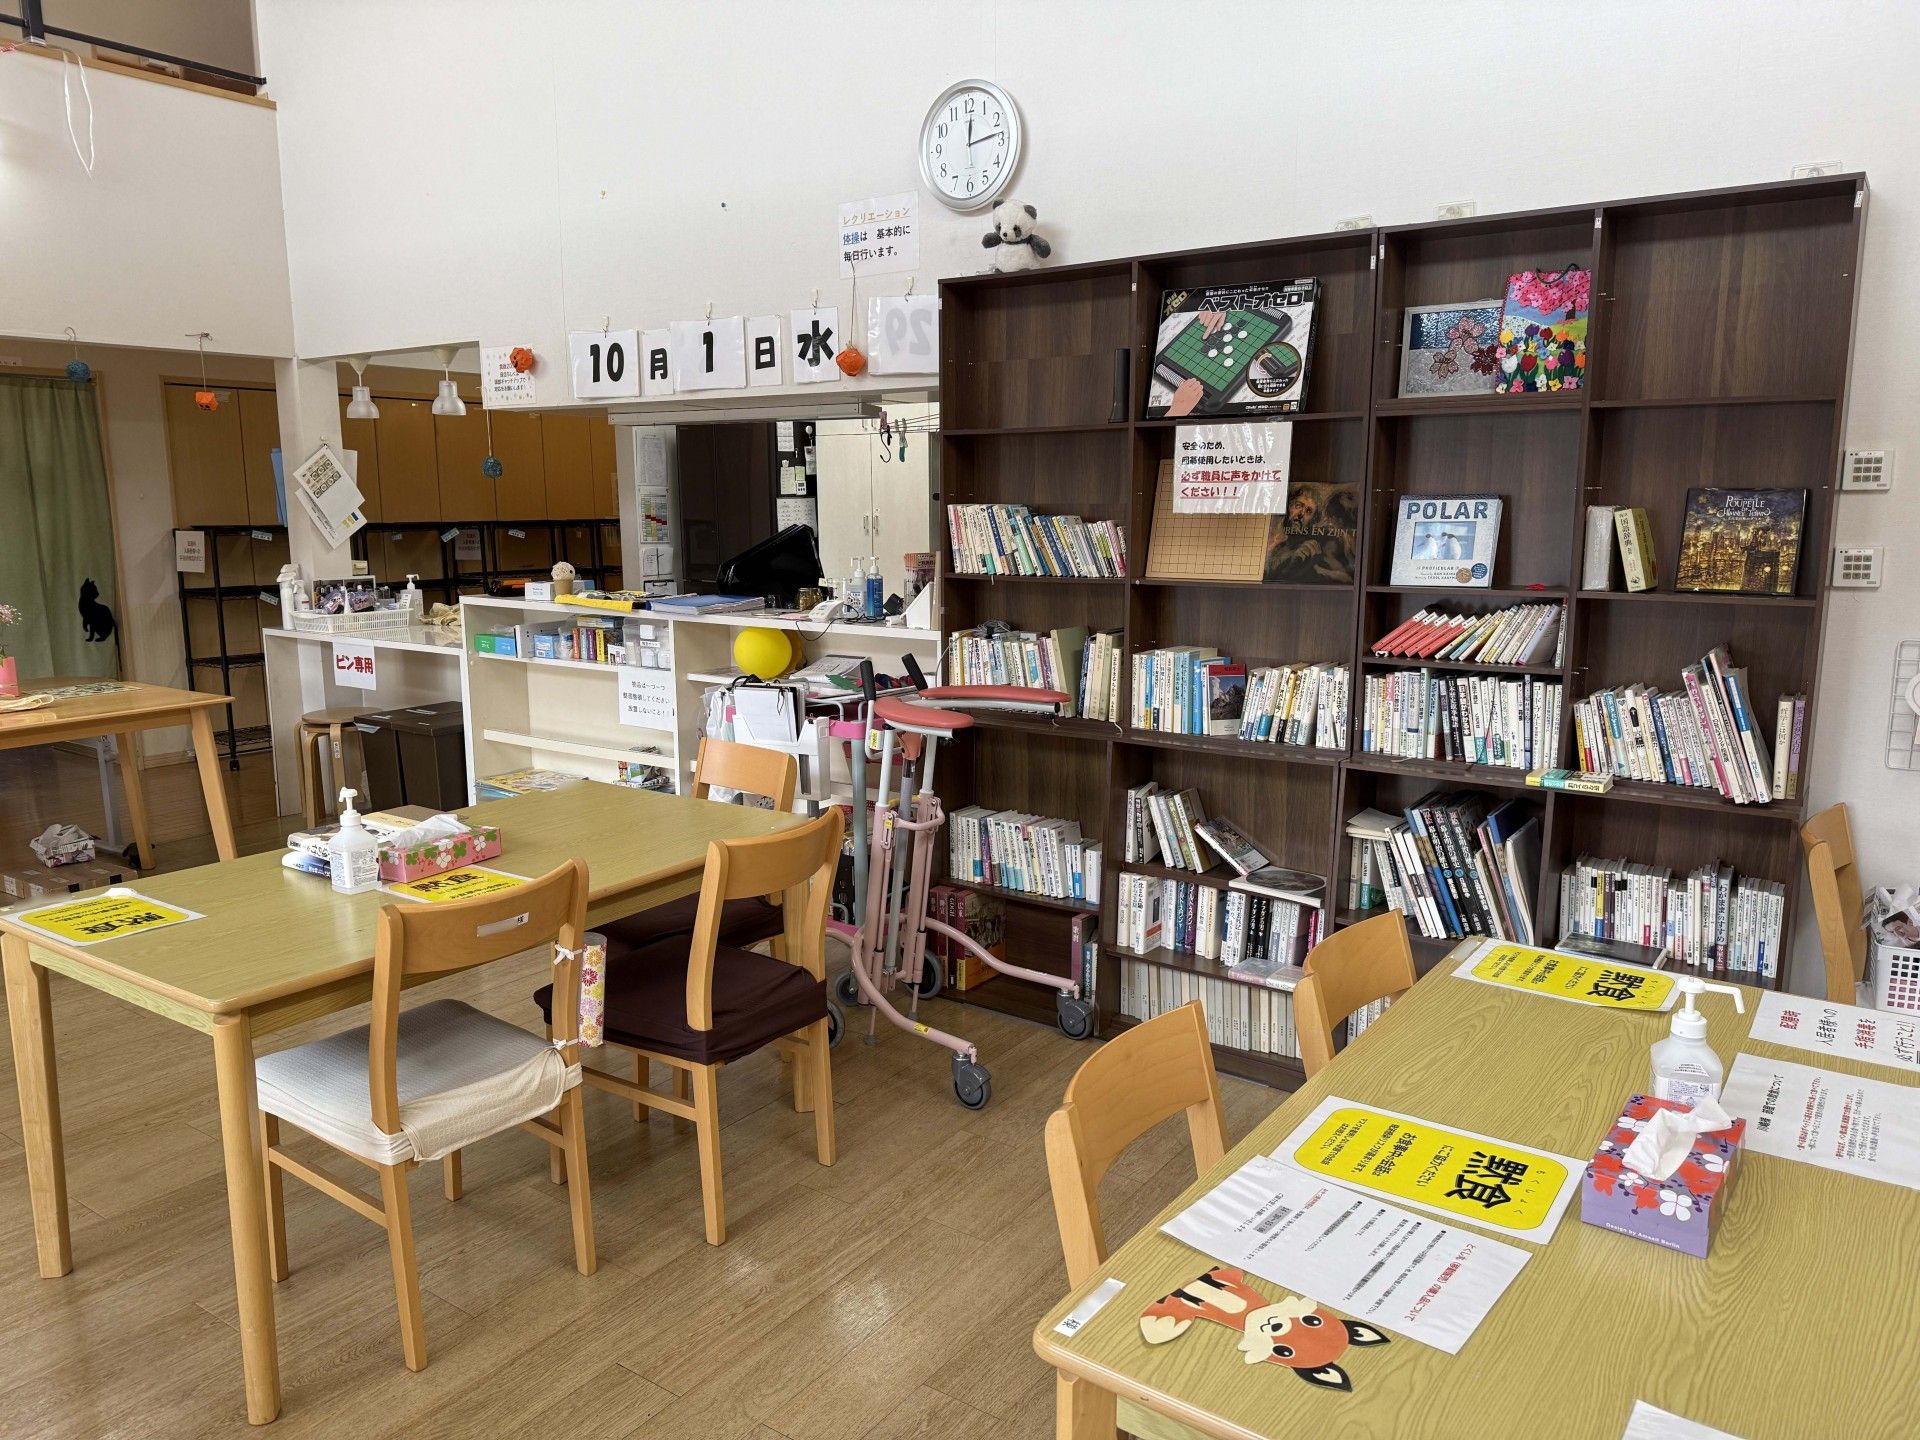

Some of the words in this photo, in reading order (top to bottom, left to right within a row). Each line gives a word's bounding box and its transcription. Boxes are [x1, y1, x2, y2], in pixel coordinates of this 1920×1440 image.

[949, 105, 959, 122] 11
[964, 97, 975, 113] 12
[982, 100, 987, 116] 1
[993, 112, 1001, 127] 2
[936, 123, 948, 139] 10
[998, 131, 1005, 147] 3
[935, 144, 942, 159] 9
[993, 153, 1001, 168] 4
[940, 163, 947, 179] 8
[981, 170, 989, 186] 5
[951, 175, 959, 192] 7
[966, 177, 974, 193] 6
[843, 206, 911, 225] レクリエーション
[843, 231, 868, 245] 体操は
[876, 225, 911, 240] 基本的に
[843, 245, 898, 262] 毎日行います。
[1198, 291, 1305, 313] ベストオセロ
[589, 343, 624, 383] 10
[650, 347, 668, 380] 月
[702, 331, 713, 373] 1
[755, 335, 775, 370] 日
[797, 320, 834, 367] 水
[1182, 441, 1225, 451] 安全のため、
[1181, 469, 1282, 482] 必ず職員に声をかけて
[1406, 501, 1489, 520] POLAR
[1311, 527, 1325, 536] EN
[336, 654, 374, 674] ビン専用
[1584, 969, 1648, 1003] 黙食
[1853, 1017, 1876, 1050] 手指消毒を
[1368, 1131, 1419, 1178] お食事中の会話は
[1411, 1144, 1456, 1188] にご協力ください
[1441, 1149, 1532, 1214] 黙食
[1605, 1222, 1627, 1233] Design
[1661, 1239, 1680, 1249] Berlin
